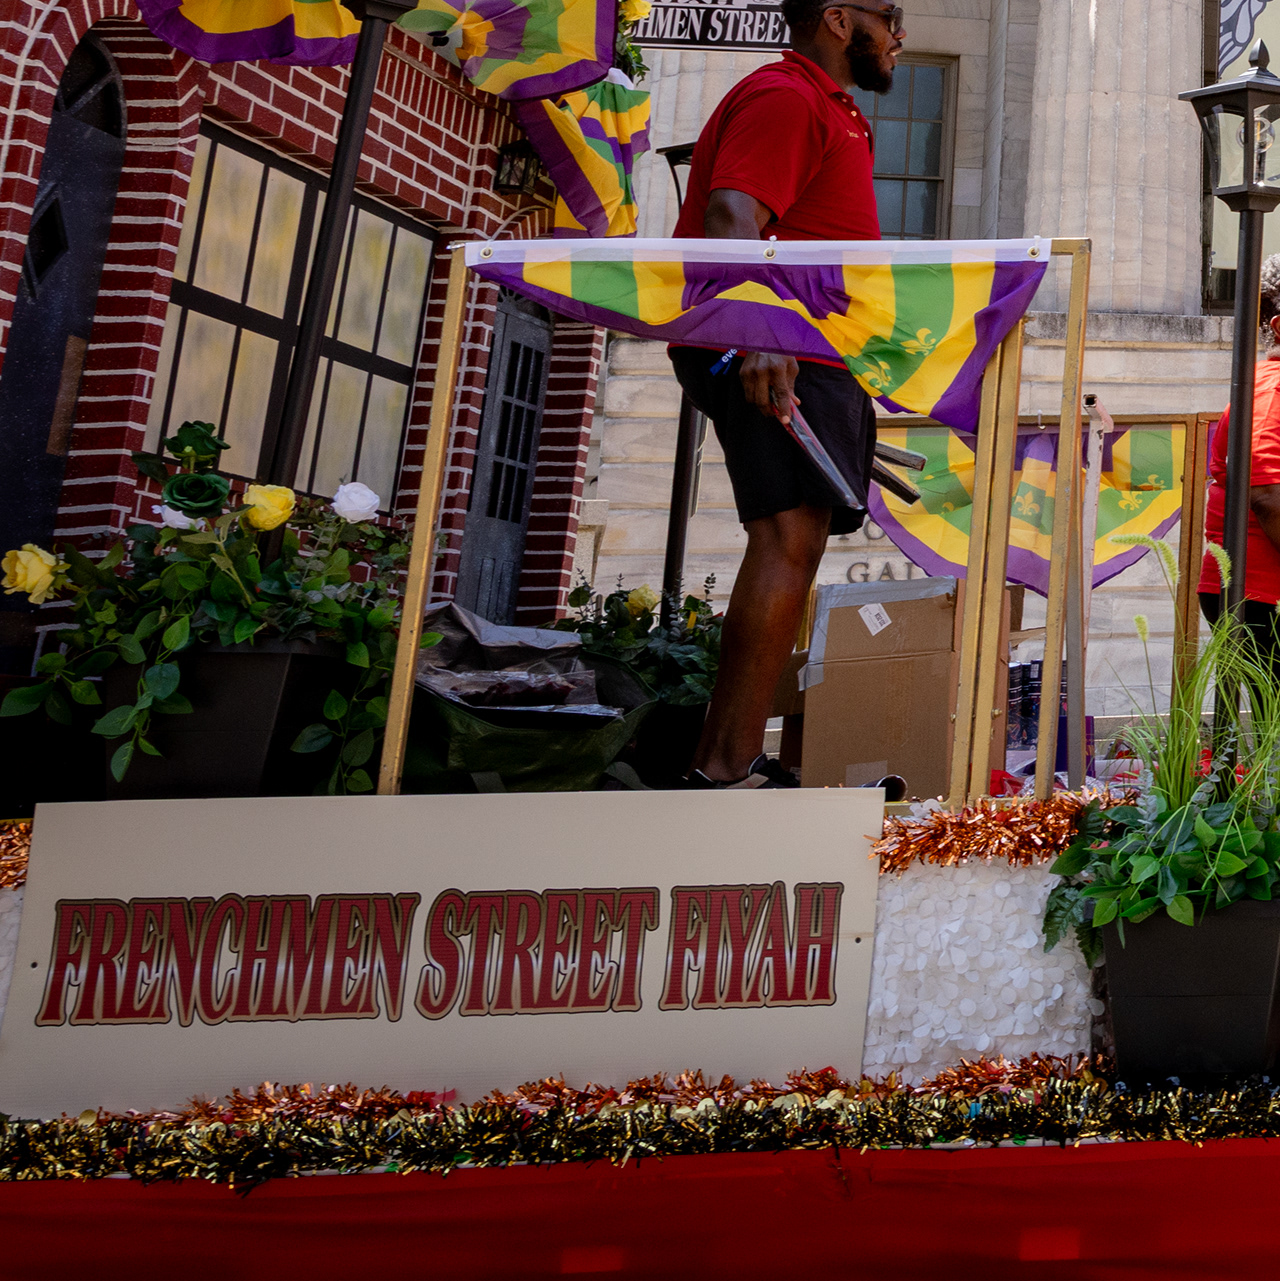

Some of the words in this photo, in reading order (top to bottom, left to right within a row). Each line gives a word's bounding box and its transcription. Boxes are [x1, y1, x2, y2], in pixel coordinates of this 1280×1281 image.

[35, 892, 421, 1027] FRENCHMEN
[414, 887, 660, 1020] STREET
[657, 880, 845, 1011] FIYAH
